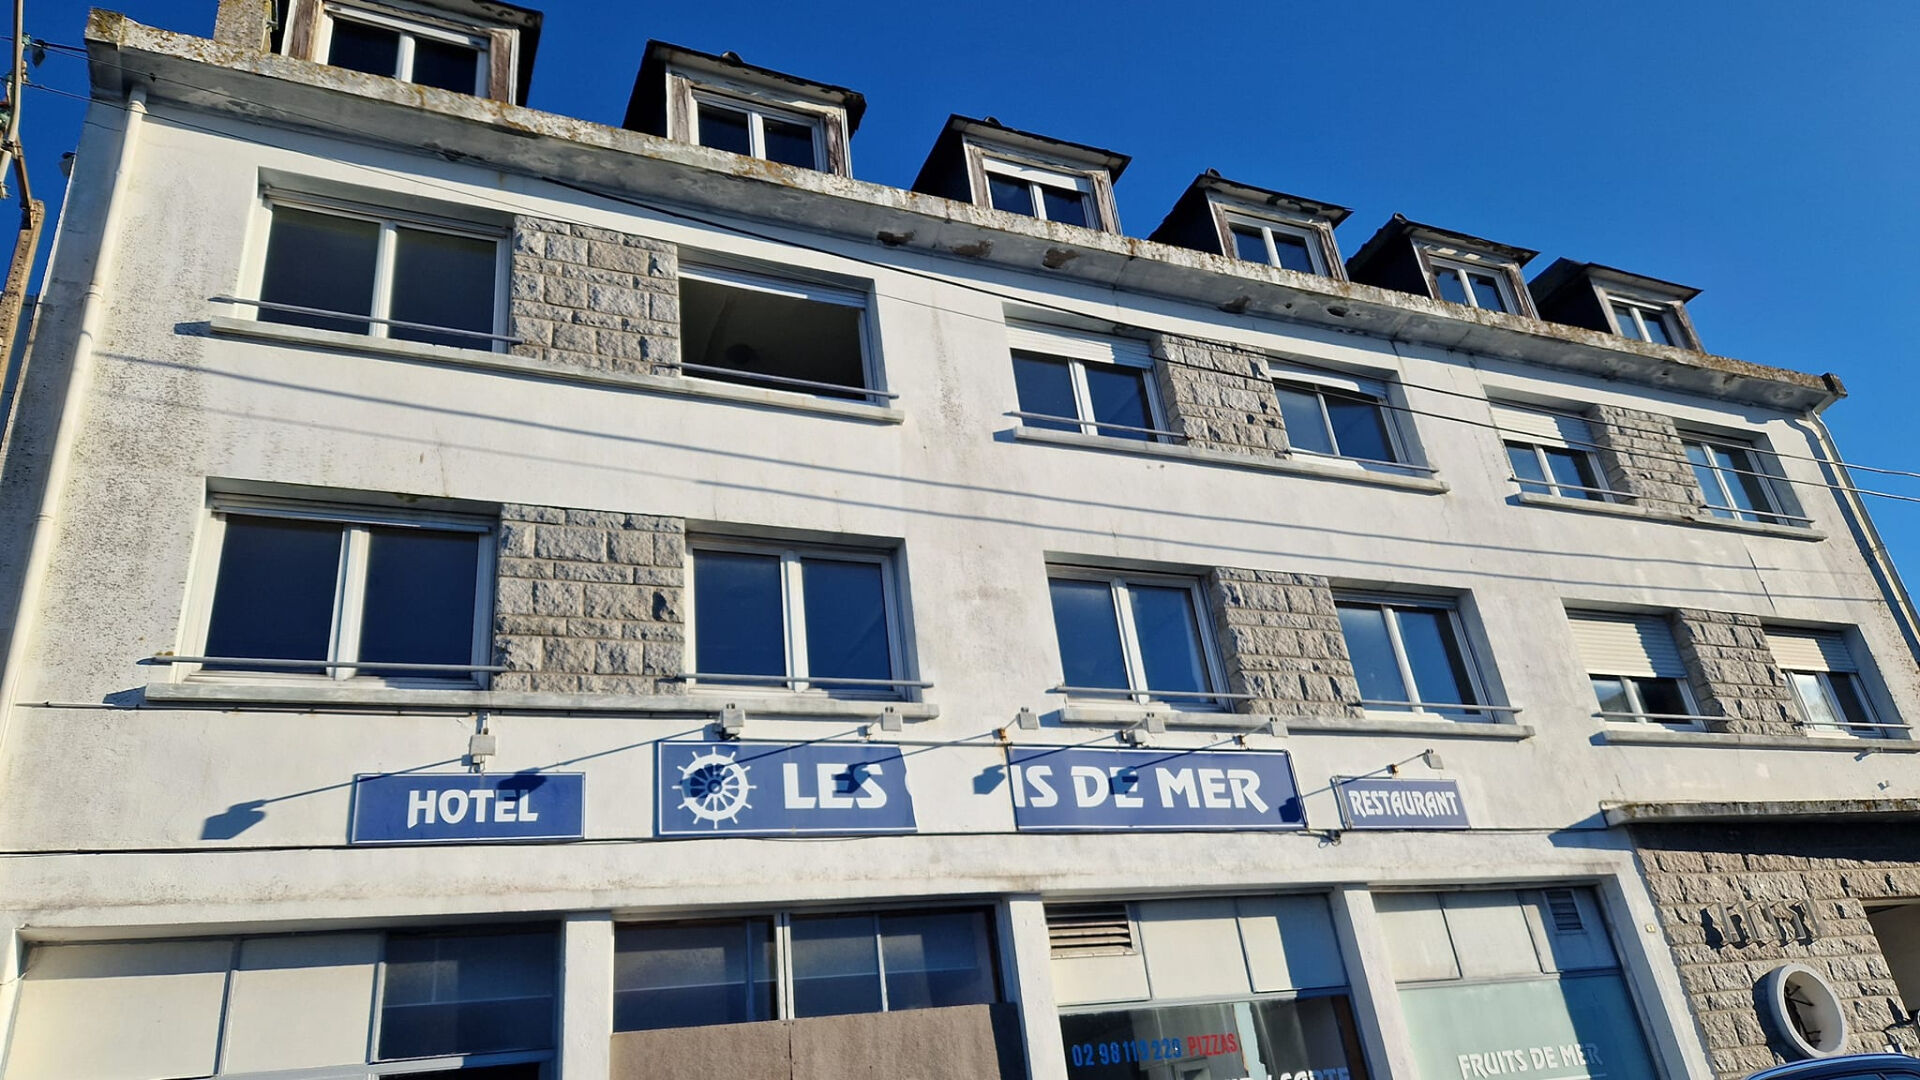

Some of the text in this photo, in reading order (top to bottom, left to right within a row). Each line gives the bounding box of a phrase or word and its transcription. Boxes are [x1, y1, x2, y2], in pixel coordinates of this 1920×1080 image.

[782, 762, 888, 809] LES
[1070, 766, 1145, 809] DE
[1155, 767, 1270, 814] MER
[1348, 790, 1459, 818] RESTAURANT
[407, 789, 539, 830] HOTEL
[1071, 1043, 1095, 1067] 02
[1098, 1041, 1121, 1065] 98
[1187, 1032, 1238, 1057] PIZZAS
[1457, 1042, 1604, 1080] FRUITS DE MER
